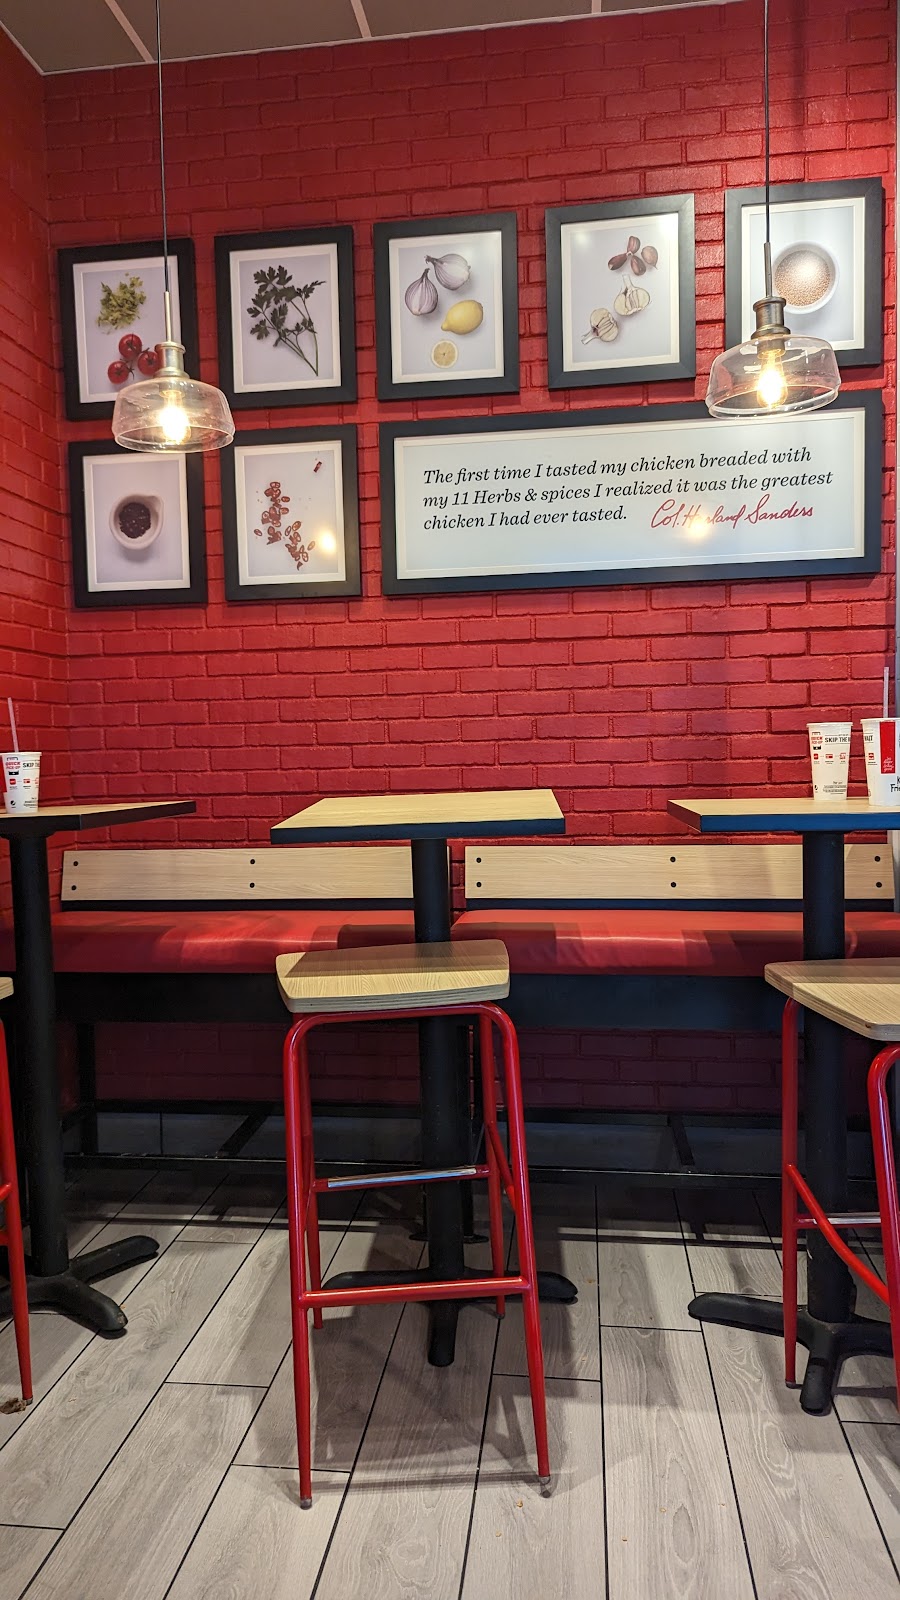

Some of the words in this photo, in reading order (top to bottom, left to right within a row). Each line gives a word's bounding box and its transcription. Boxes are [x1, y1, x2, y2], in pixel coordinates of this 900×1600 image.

[423, 468, 454, 484] The
[454, 467, 491, 486] first
[494, 465, 531, 480] time
[534, 464, 543, 478] I
[546, 460, 597, 477] tasted
[601, 461, 627, 476] my
[631, 455, 696, 473] chicken
[700, 449, 768, 468] breaded
[772, 446, 812, 464] with
[423, 495, 448, 509] my
[452, 491, 469, 506] 11
[472, 488, 521, 505] Herbs
[524, 488, 538, 502] &
[541, 485, 590, 503] spices
[594, 483, 603, 498] I
[605, 479, 673, 497] realized
[677, 479, 690, 493] it
[694, 478, 727, 491] was
[731, 475, 757, 490] the
[761, 471, 833, 491] greatest
[423, 514, 485, 530] chicken
[488, 512, 498, 526] I
[500, 510, 530, 526] had
[533, 511, 569, 524] ever
[572, 505, 627, 522] tasted.
[682, 504, 747, 529] Hrland
[744, 493, 813, 524] Sanders
